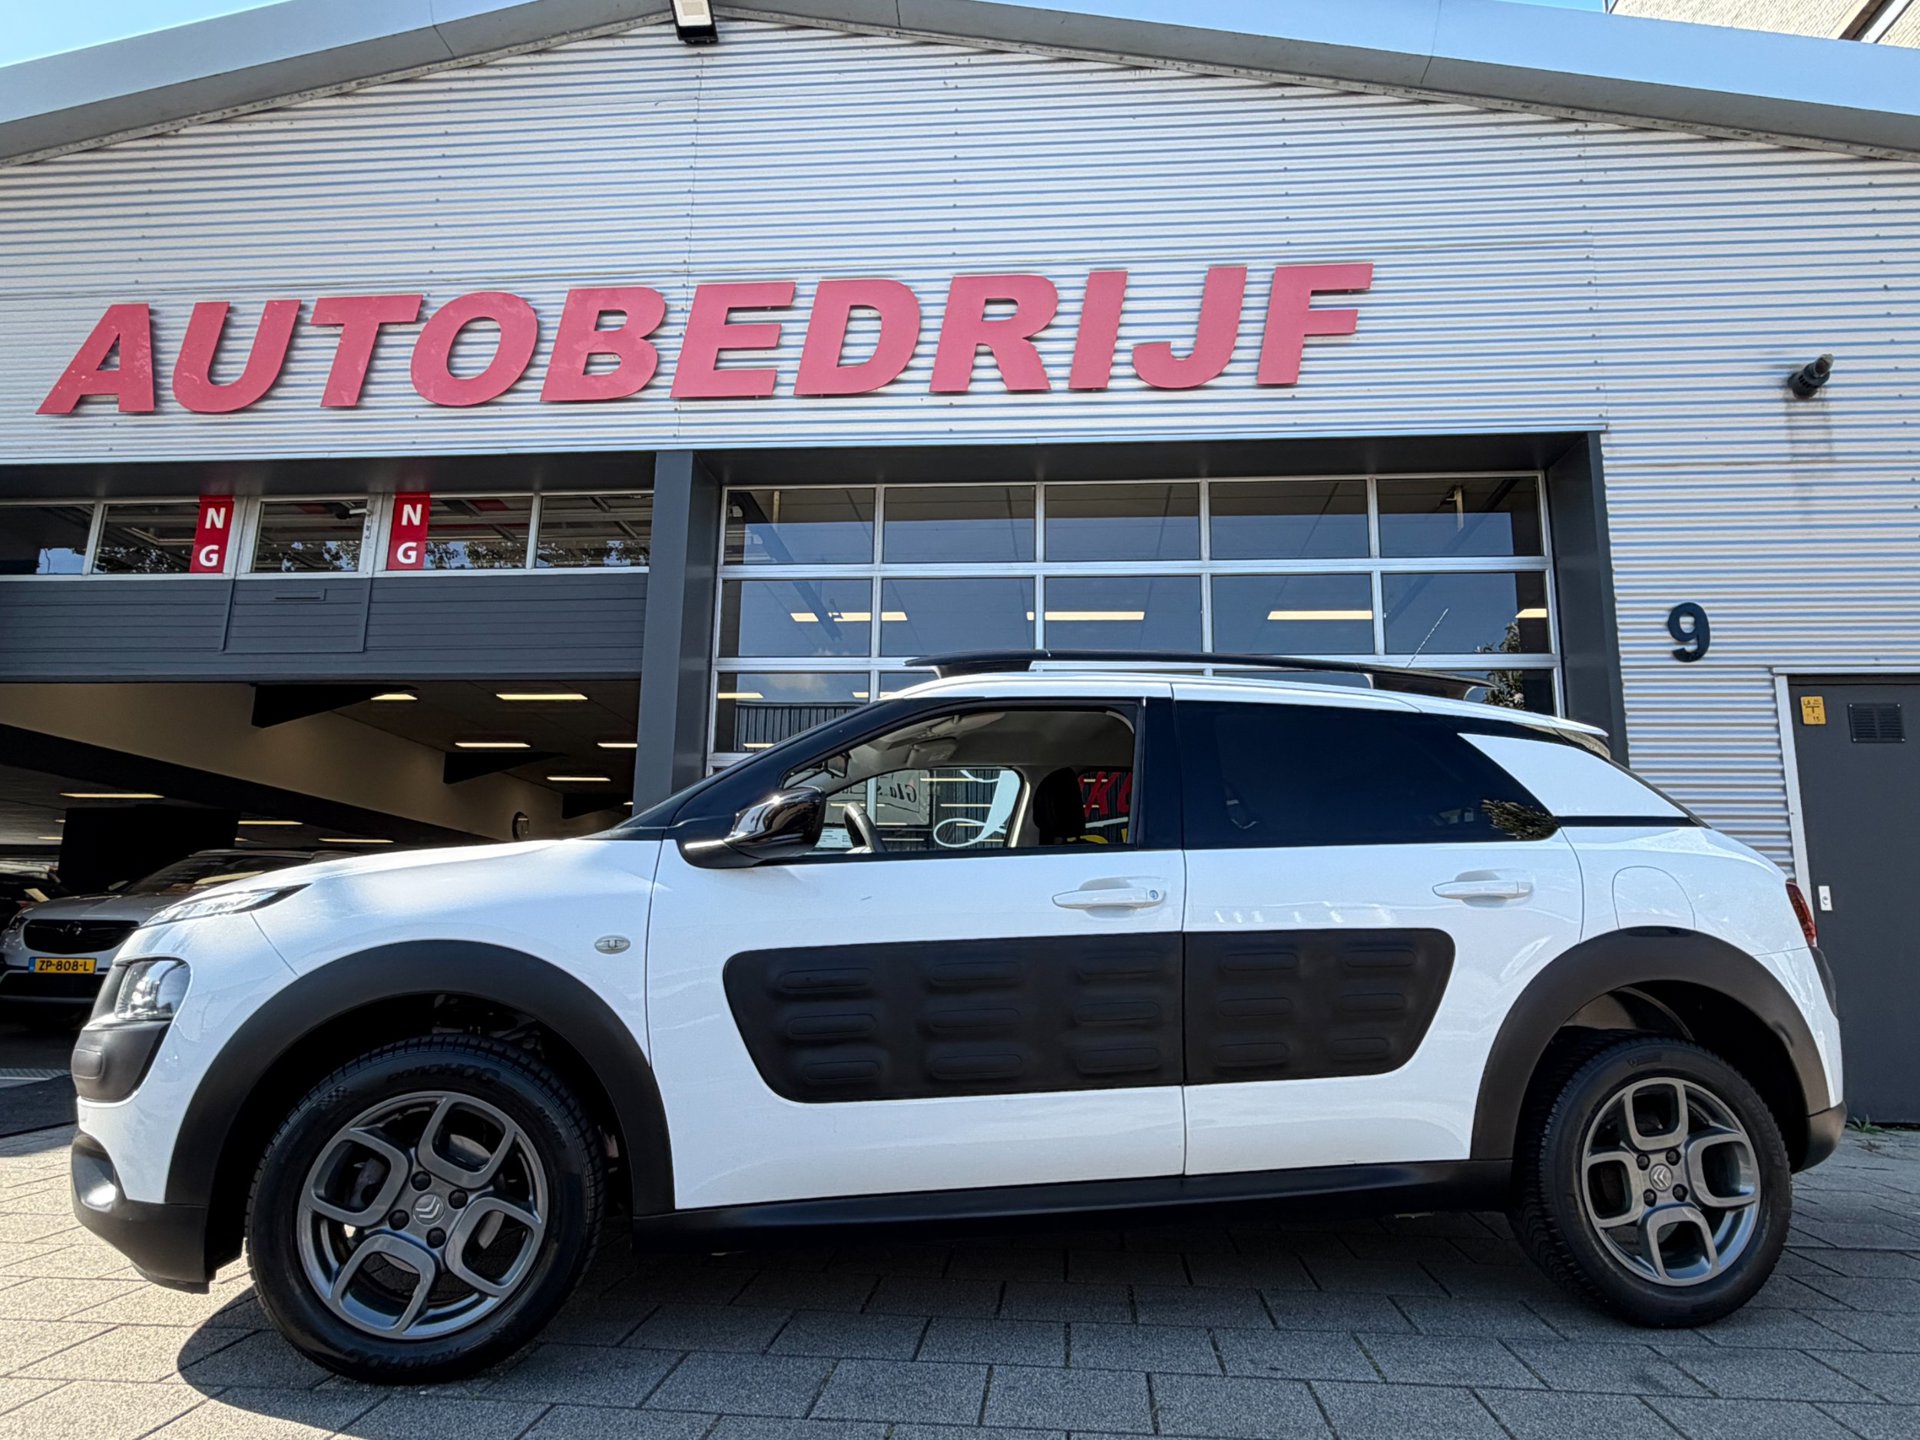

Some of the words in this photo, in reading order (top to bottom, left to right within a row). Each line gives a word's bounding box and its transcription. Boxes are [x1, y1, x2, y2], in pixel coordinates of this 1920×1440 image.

[36, 261, 1374, 415] AUTOBEDRIJF
[1667, 602, 1711, 662] 9
[38, 959, 91, 972] ZP-808-L
